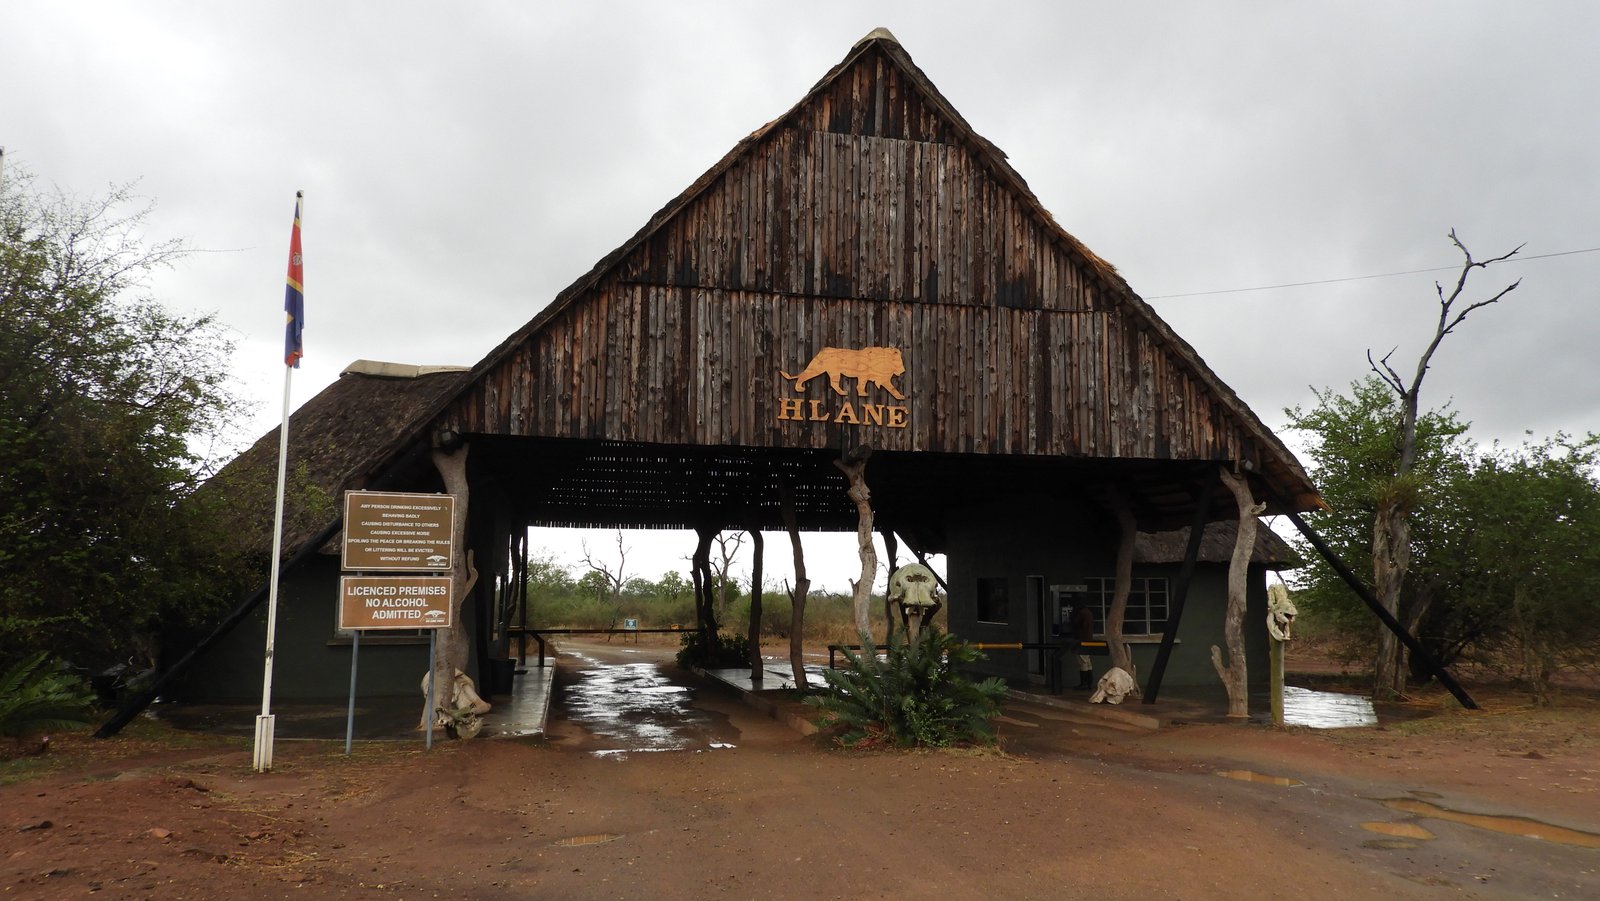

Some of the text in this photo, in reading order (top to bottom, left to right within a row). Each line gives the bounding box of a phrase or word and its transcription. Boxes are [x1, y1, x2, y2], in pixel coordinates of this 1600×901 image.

[777, 397, 909, 428] HLANE
[348, 586, 446, 596] LICENCED PREMISES
[366, 598, 428, 607] NO ALCOHOL
[372, 610, 421, 619] ADMITTED
